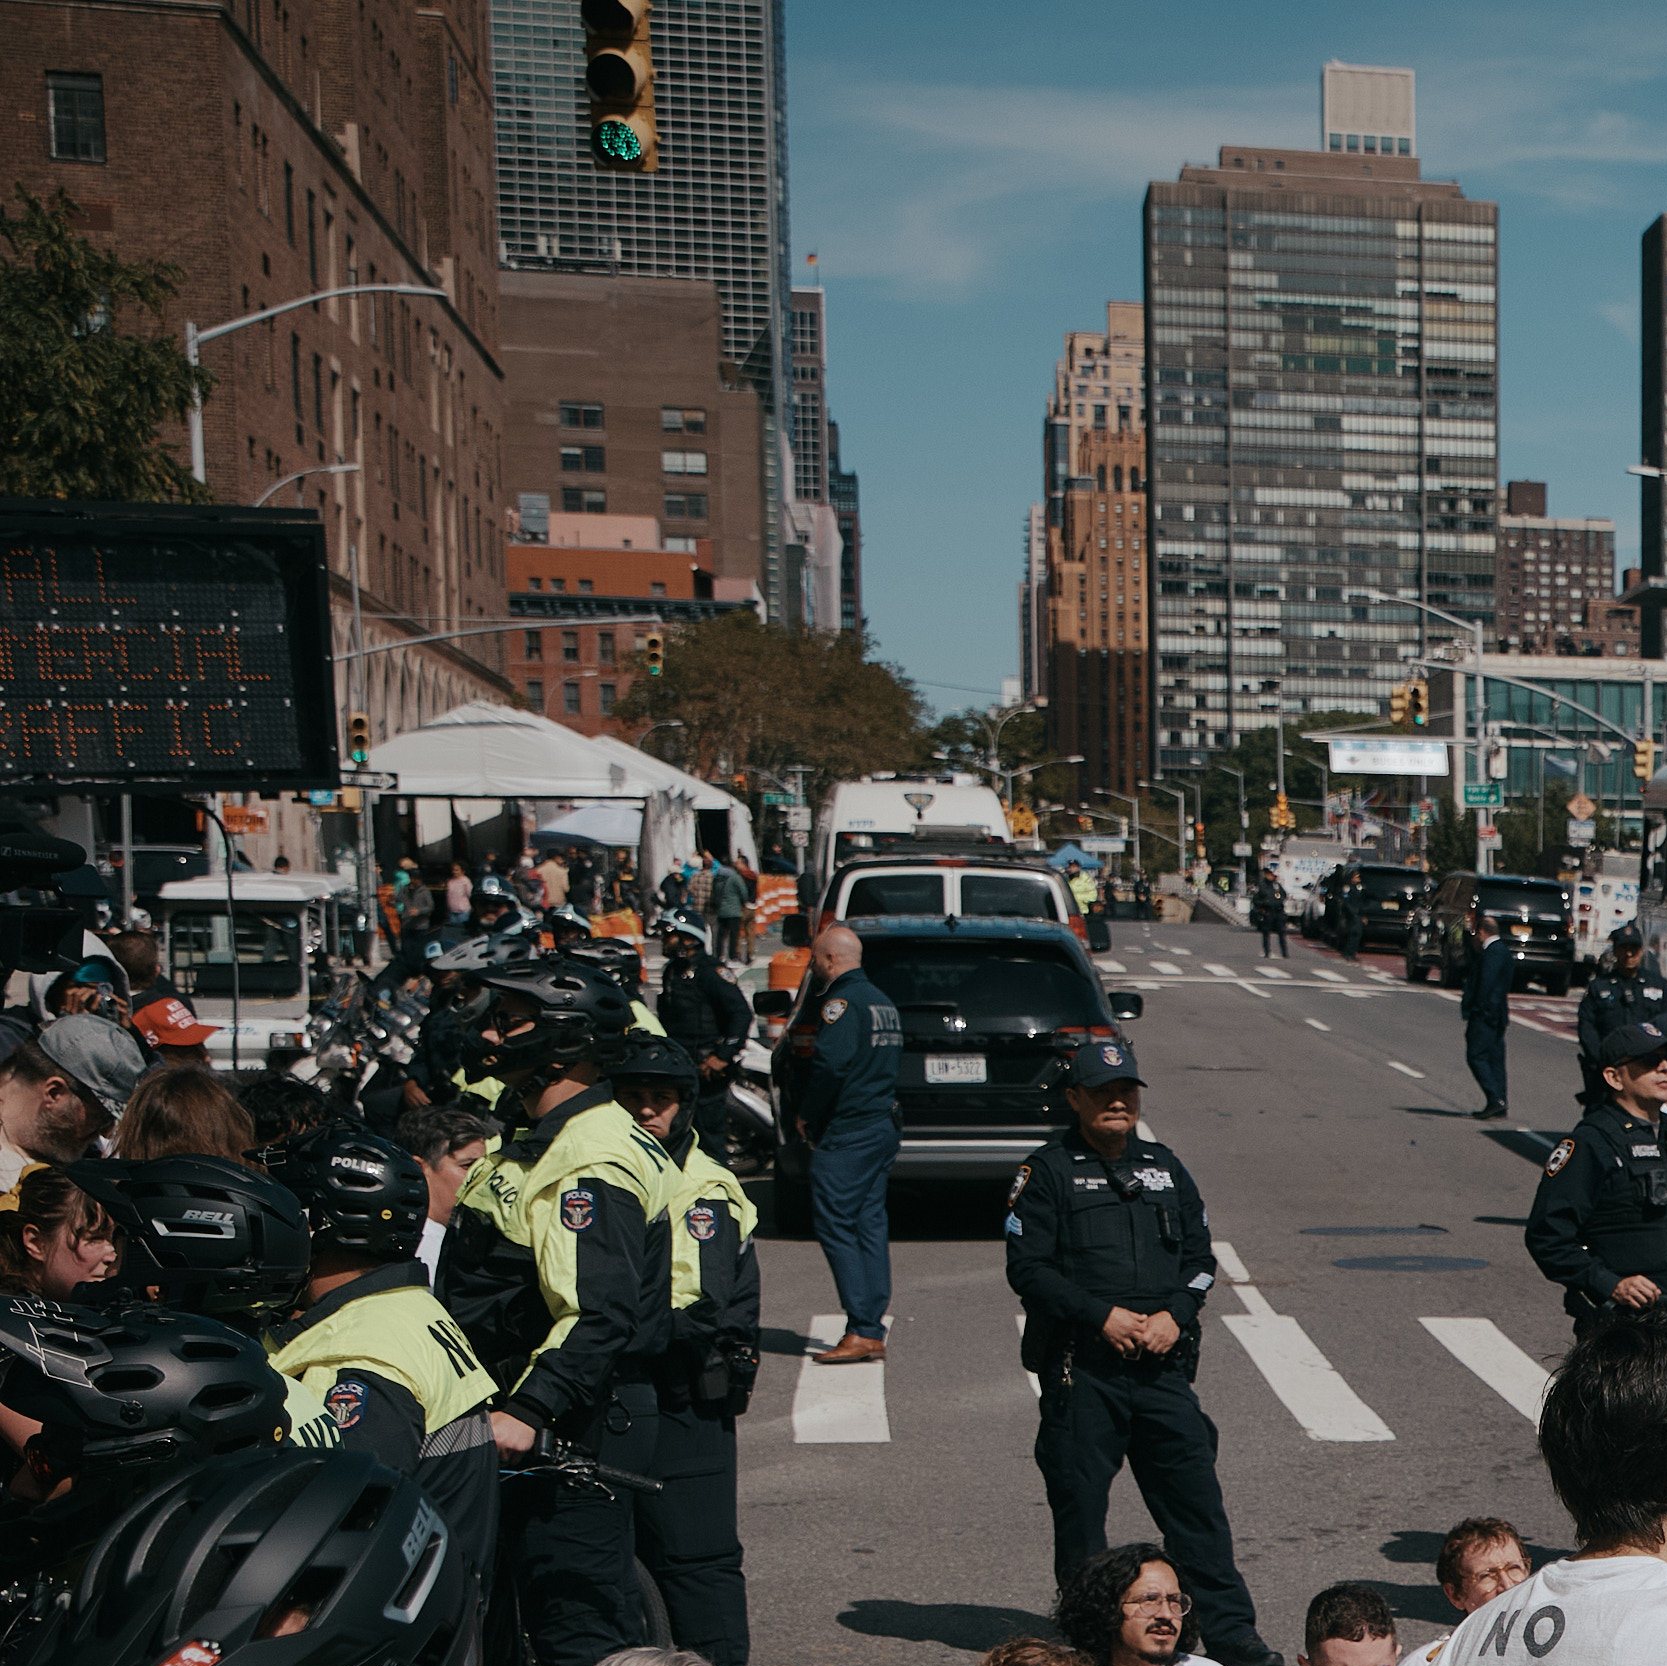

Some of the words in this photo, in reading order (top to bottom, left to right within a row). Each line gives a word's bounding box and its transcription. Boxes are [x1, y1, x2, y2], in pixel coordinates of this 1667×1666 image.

[2, 549, 138, 603] ALL
[0, 627, 272, 681] MERCIAL
[13, 849, 60, 860] SENNHEISER
[330, 1155, 386, 1175] POLICE
[565, 1191, 594, 1202] POLICE
[182, 1209, 235, 1225] BELL
[689, 1206, 714, 1218] POLICE
[331, 1383, 365, 1398] POLICE
[401, 1497, 438, 1568] BELL
[1477, 1604, 1567, 1659] NO
